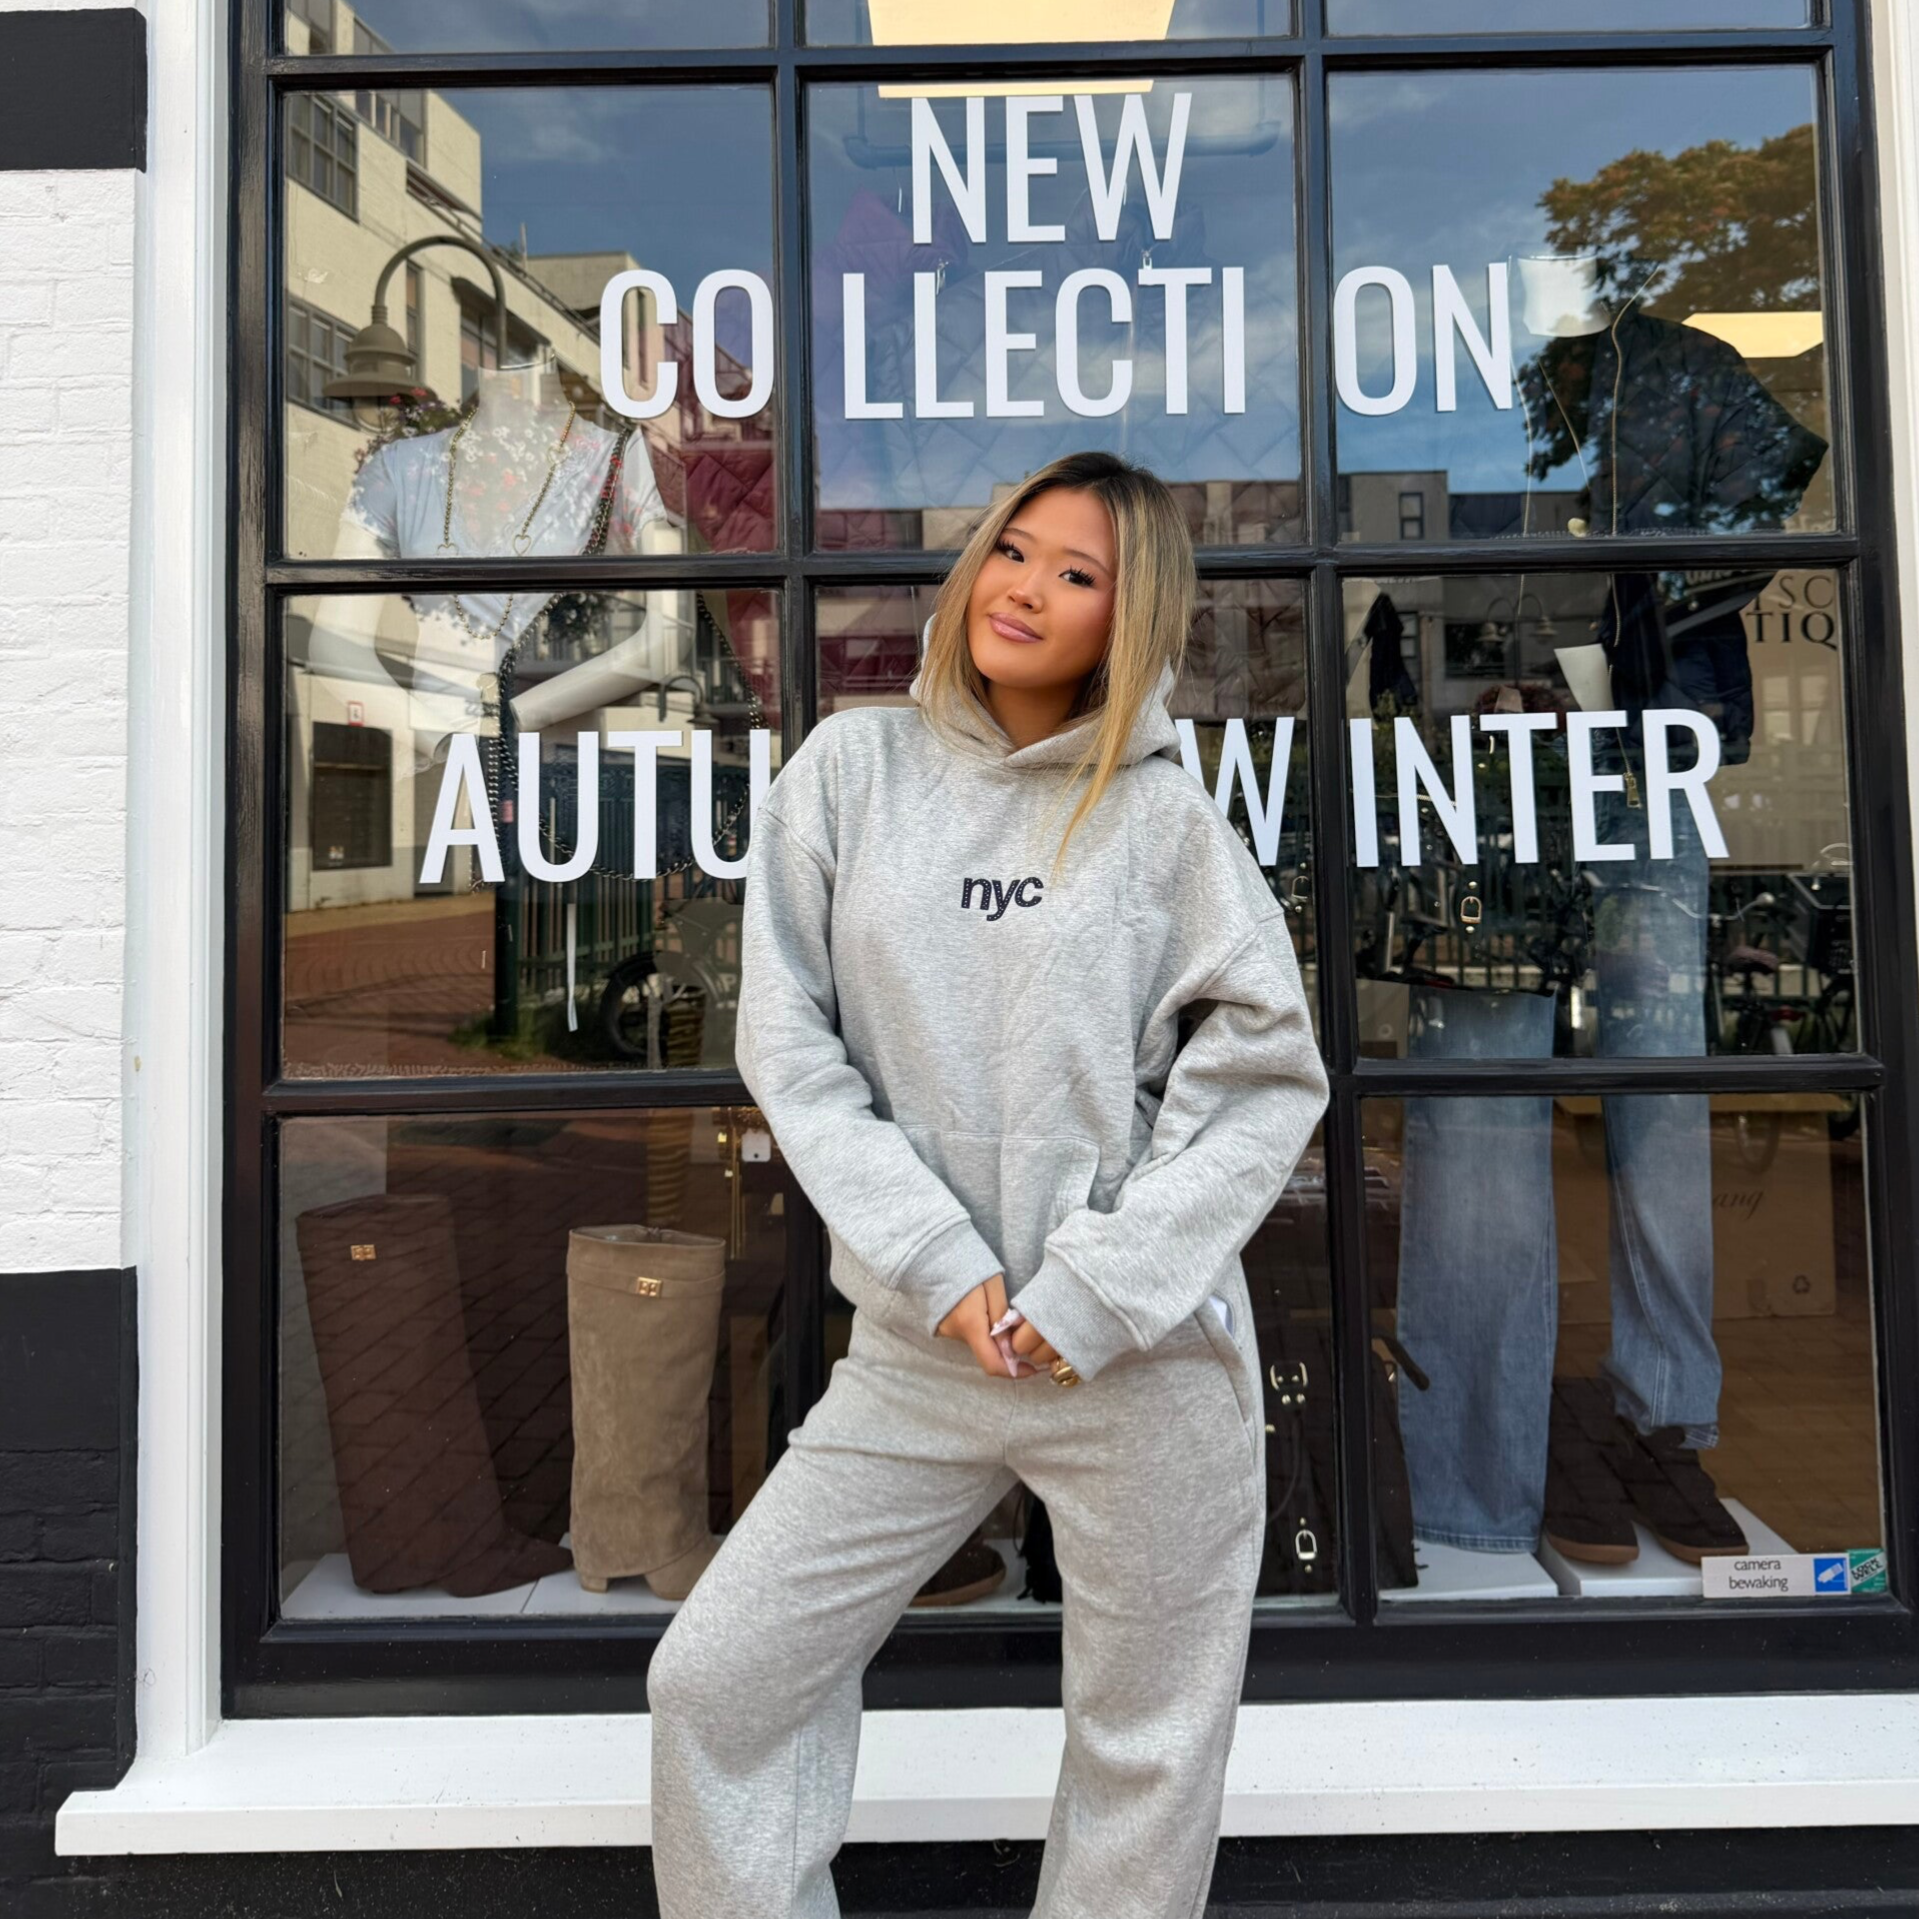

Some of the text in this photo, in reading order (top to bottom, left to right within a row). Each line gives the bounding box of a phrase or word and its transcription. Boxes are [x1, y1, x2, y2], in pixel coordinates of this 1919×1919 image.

[911, 92, 1192, 245] NEW
[599, 262, 1512, 420] COLLECTION
[961, 876, 1044, 922] nyc
[1728, 1576, 1789, 1592] bewaking
[1734, 1558, 1781, 1571] camera
